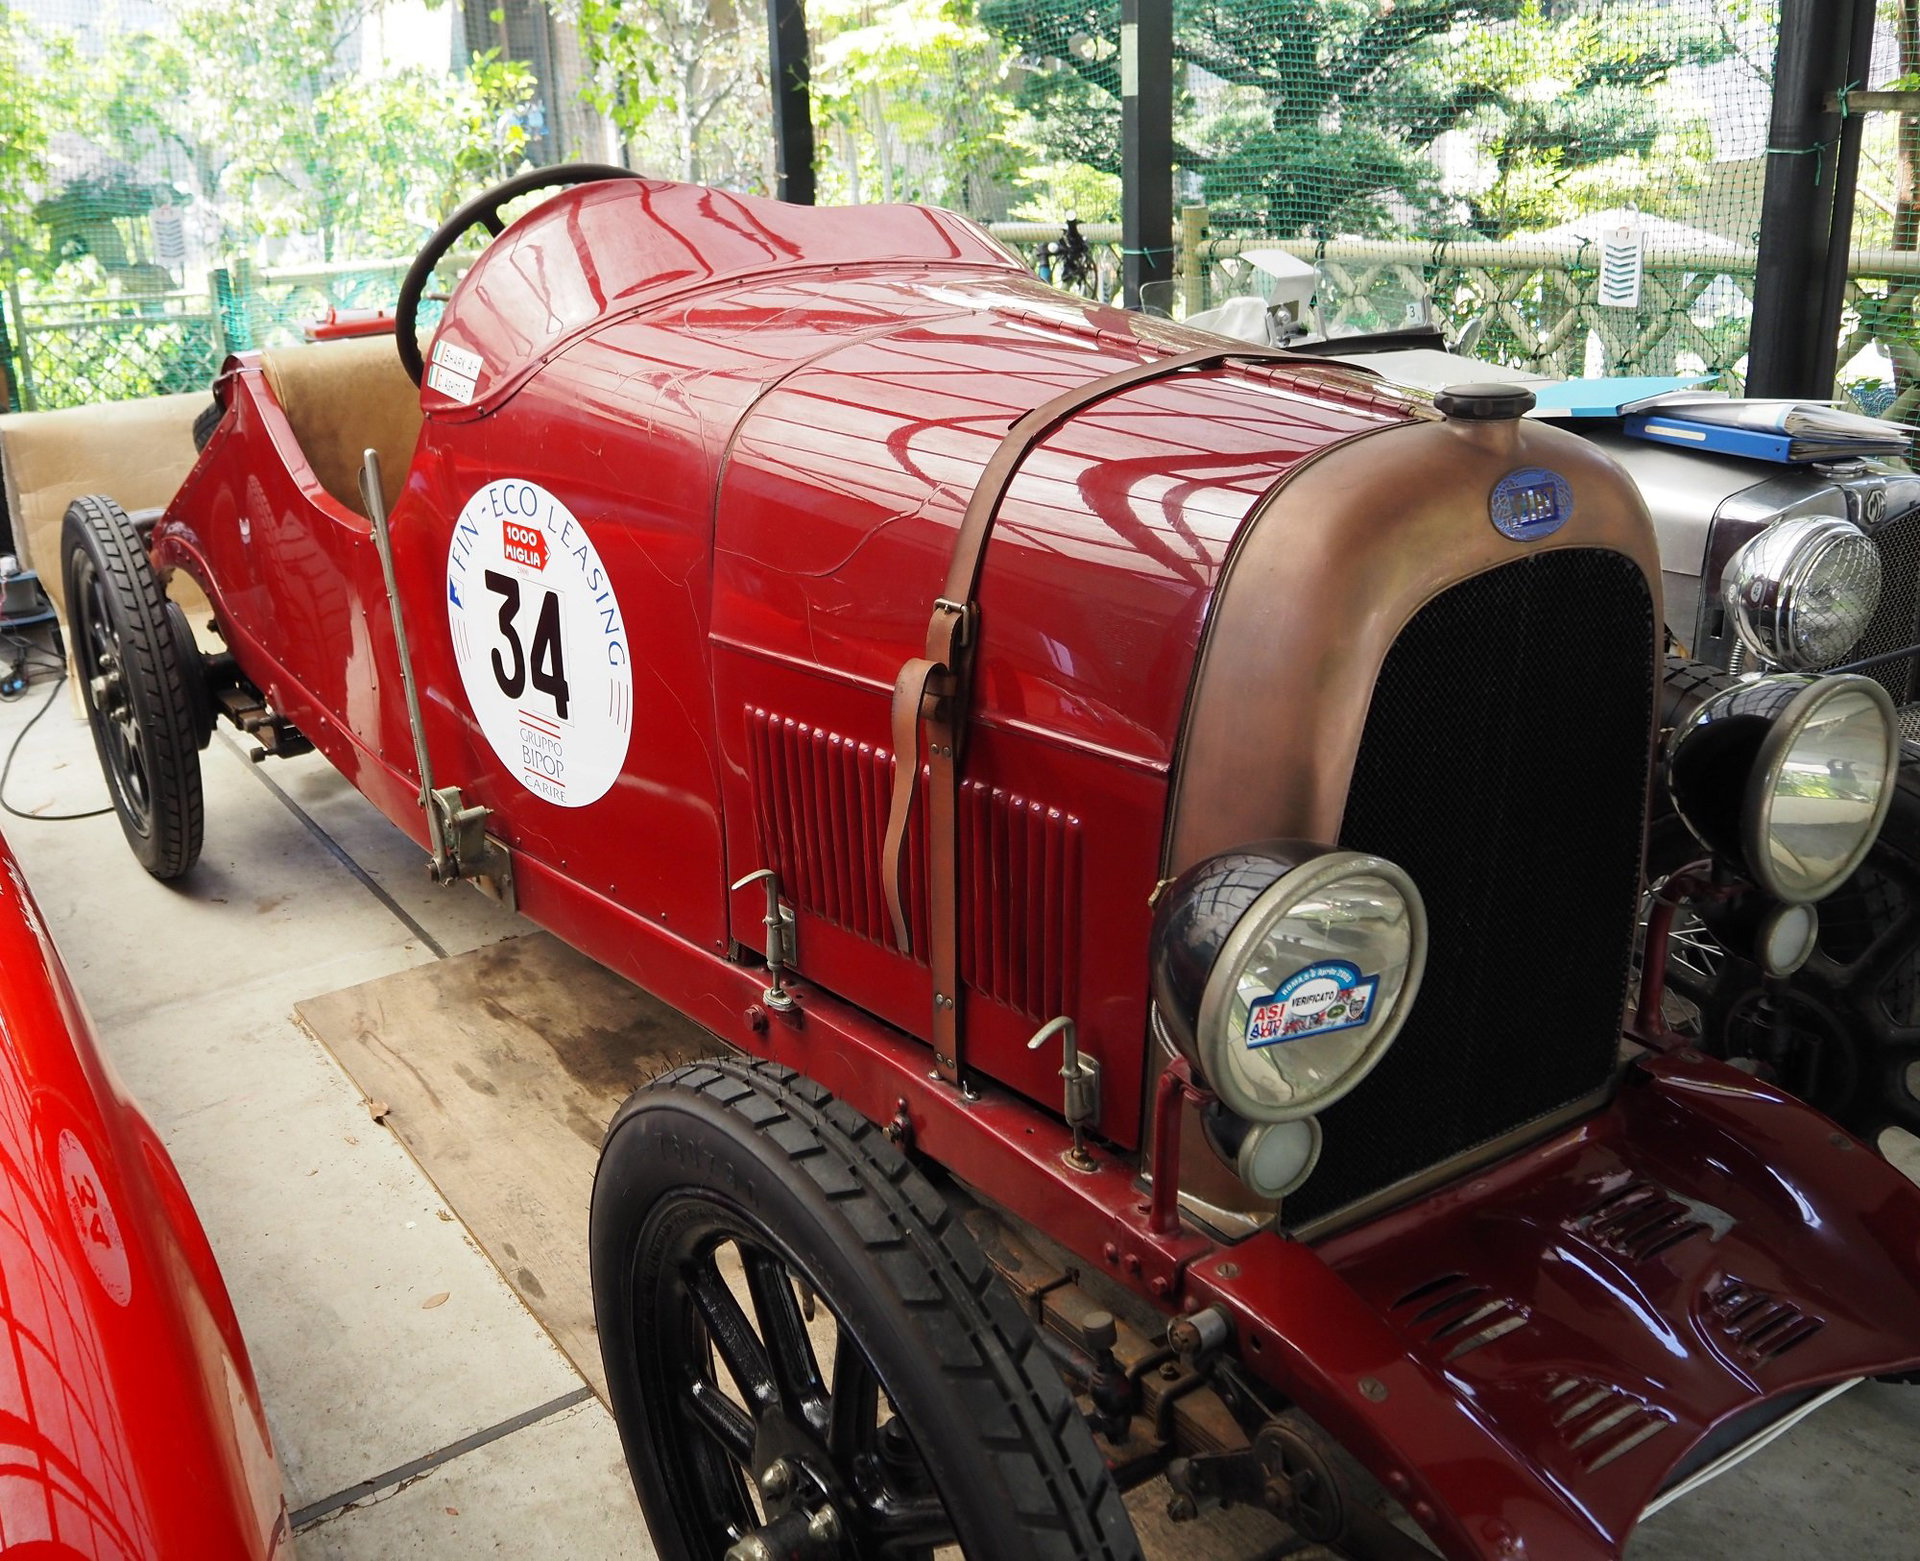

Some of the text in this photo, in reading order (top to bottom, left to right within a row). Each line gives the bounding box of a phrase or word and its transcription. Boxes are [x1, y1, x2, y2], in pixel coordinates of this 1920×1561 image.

[506, 525, 538, 547] 1000
[505, 544, 541, 567] MIGLIA
[548, 505, 626, 666] LEASING
[484, 569, 570, 720] 34
[520, 727, 563, 757] GRUPPO
[522, 744, 565, 778] BIPOP
[524, 774, 567, 803] CARIRE
[1254, 1003, 1285, 1022] ASI
[1291, 991, 1335, 1008] VERIFICATO
